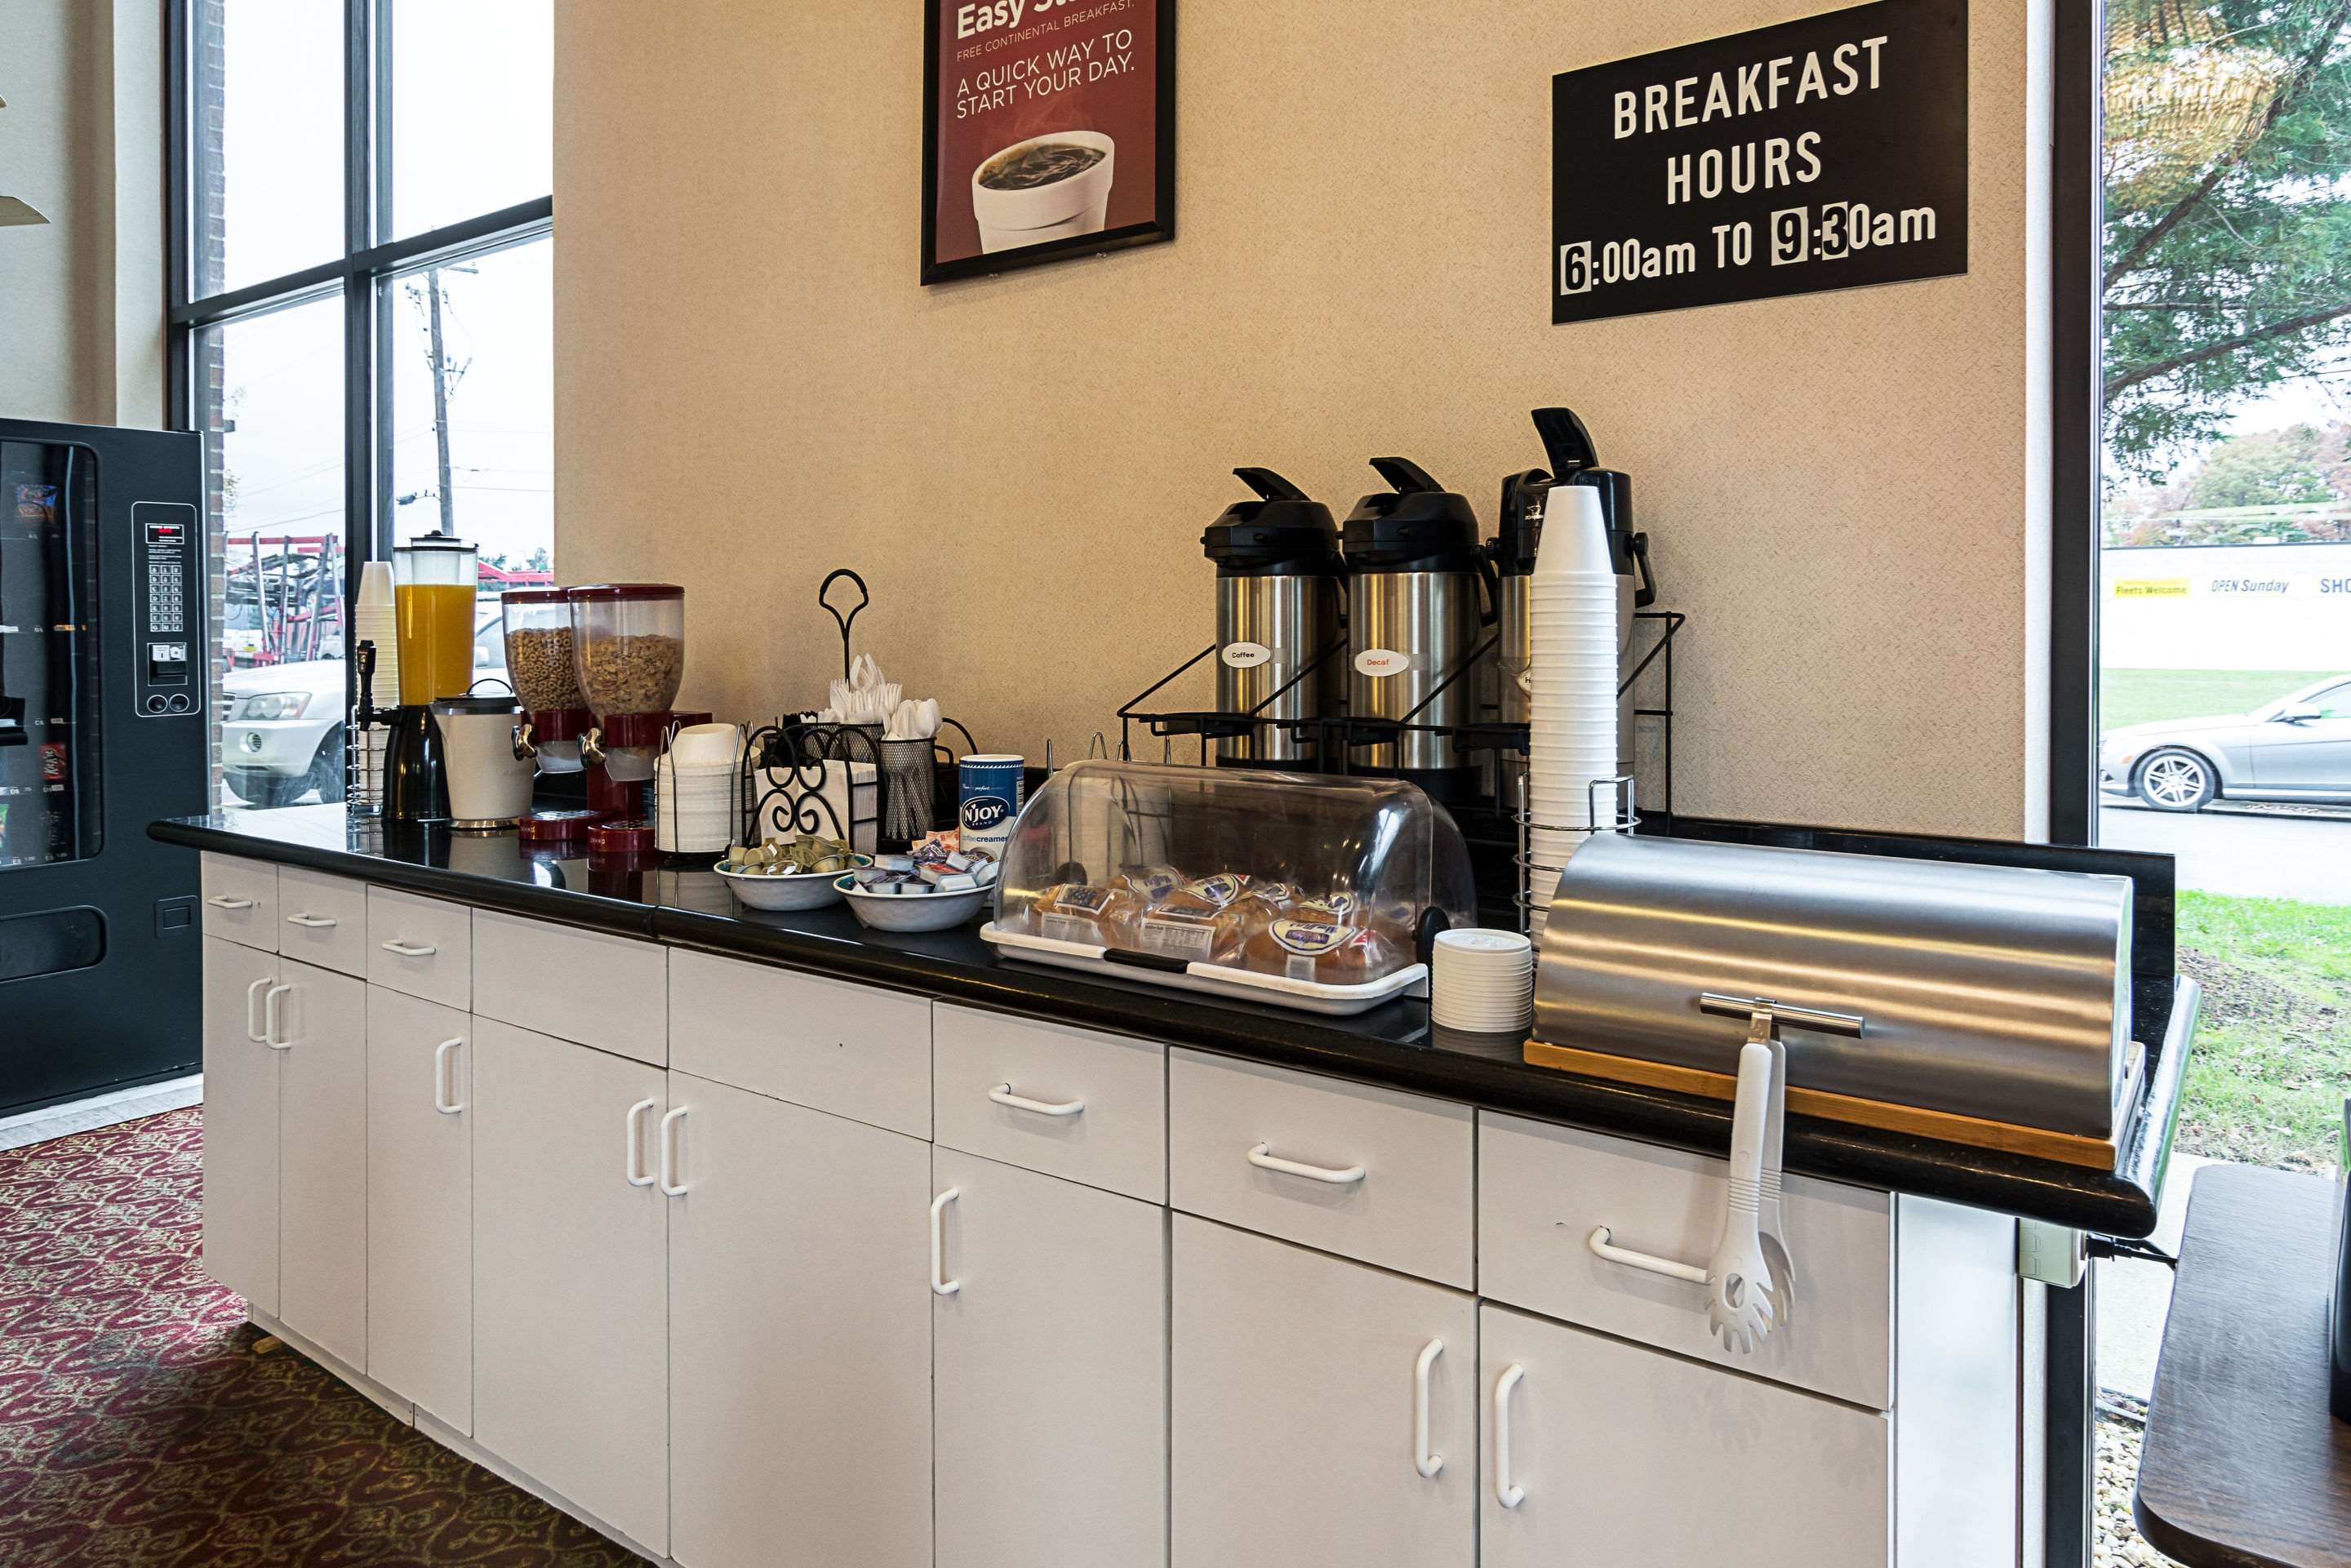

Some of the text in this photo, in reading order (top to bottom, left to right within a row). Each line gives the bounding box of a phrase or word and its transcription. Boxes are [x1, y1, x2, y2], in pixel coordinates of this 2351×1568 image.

[957, 44, 982, 62] FREE
[984, 20, 1060, 52] CONTINENTAL
[958, 0, 1025, 40] Easy
[957, 29, 1132, 98] A QUICK WAY TO
[957, 51, 1135, 118] START YOUR DAY.
[1614, 35, 1888, 140] BREAKFAST
[1667, 131, 1822, 206] HOURS
[1562, 202, 1936, 293] 6:00am TO 9:30am
[2144, 586, 2188, 595] Welcome
[2211, 579, 2290, 593] OPEN Sunday
[1232, 651, 1255, 659] Coffee
